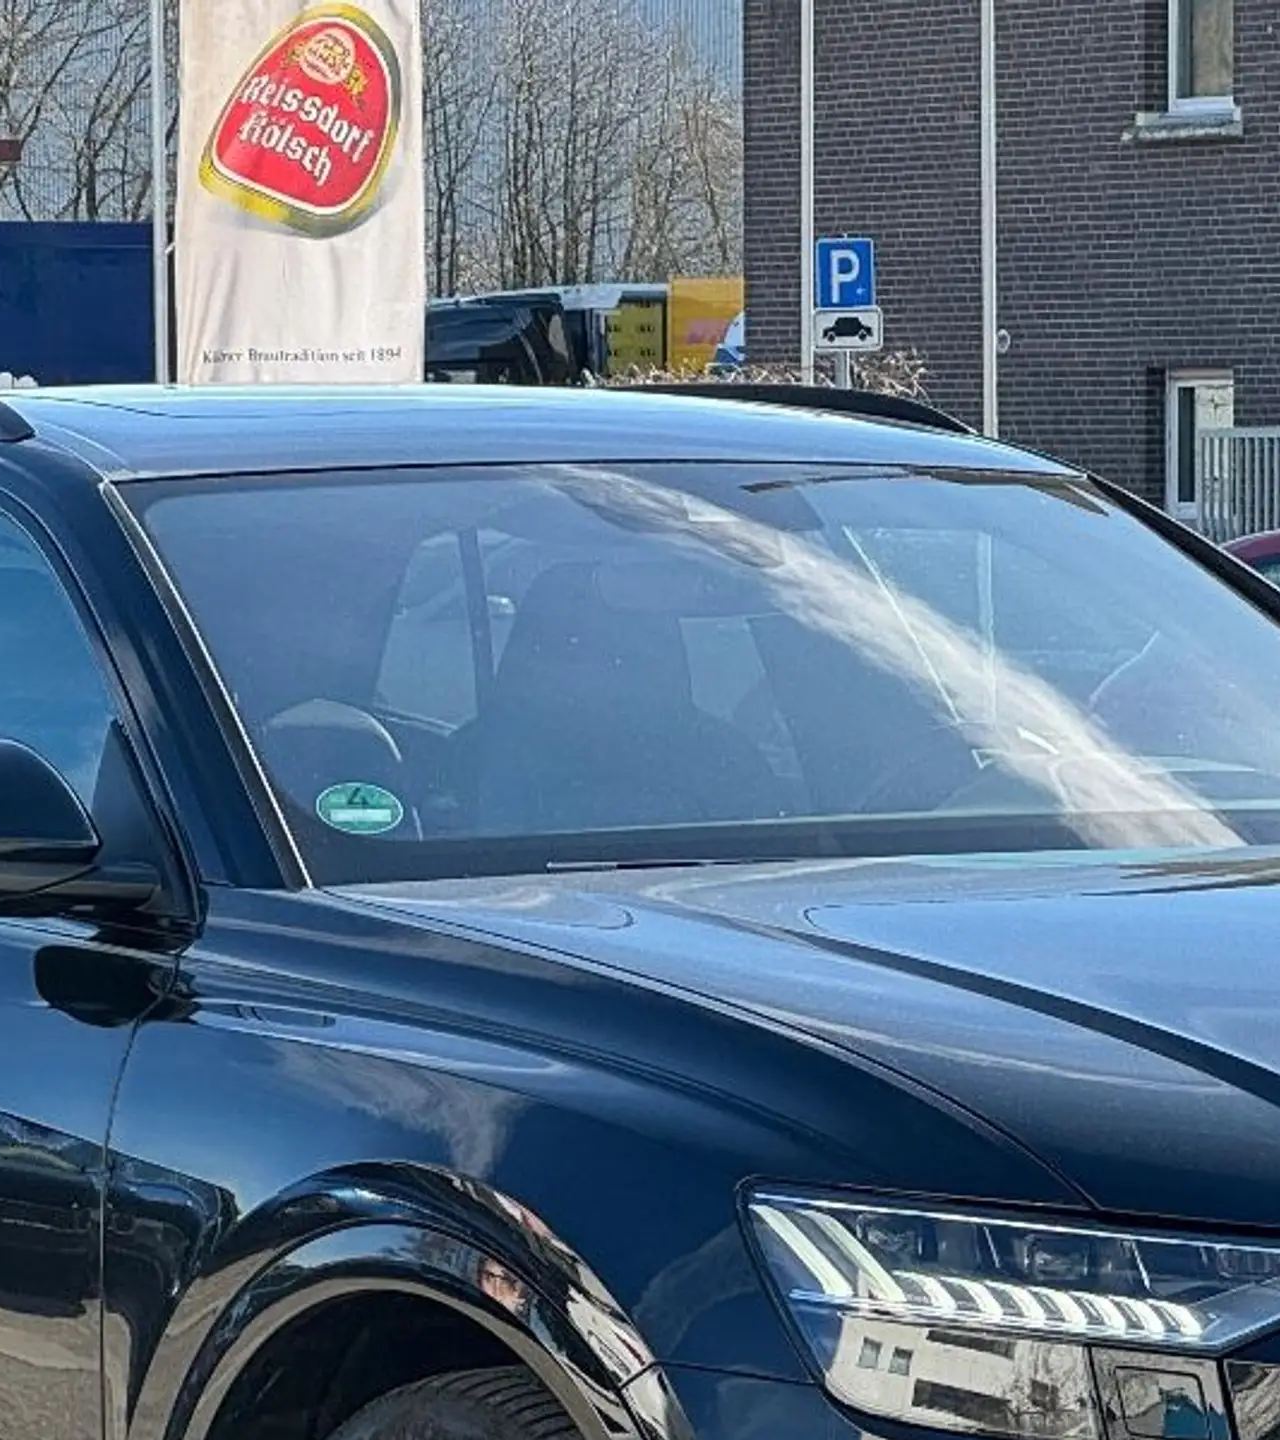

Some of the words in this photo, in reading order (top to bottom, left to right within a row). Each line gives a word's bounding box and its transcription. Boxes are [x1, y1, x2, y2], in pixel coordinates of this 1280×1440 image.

[237, 74, 374, 163] Reissdorf
[238, 109, 332, 187] Kölsch
[830, 249, 859, 304] P
